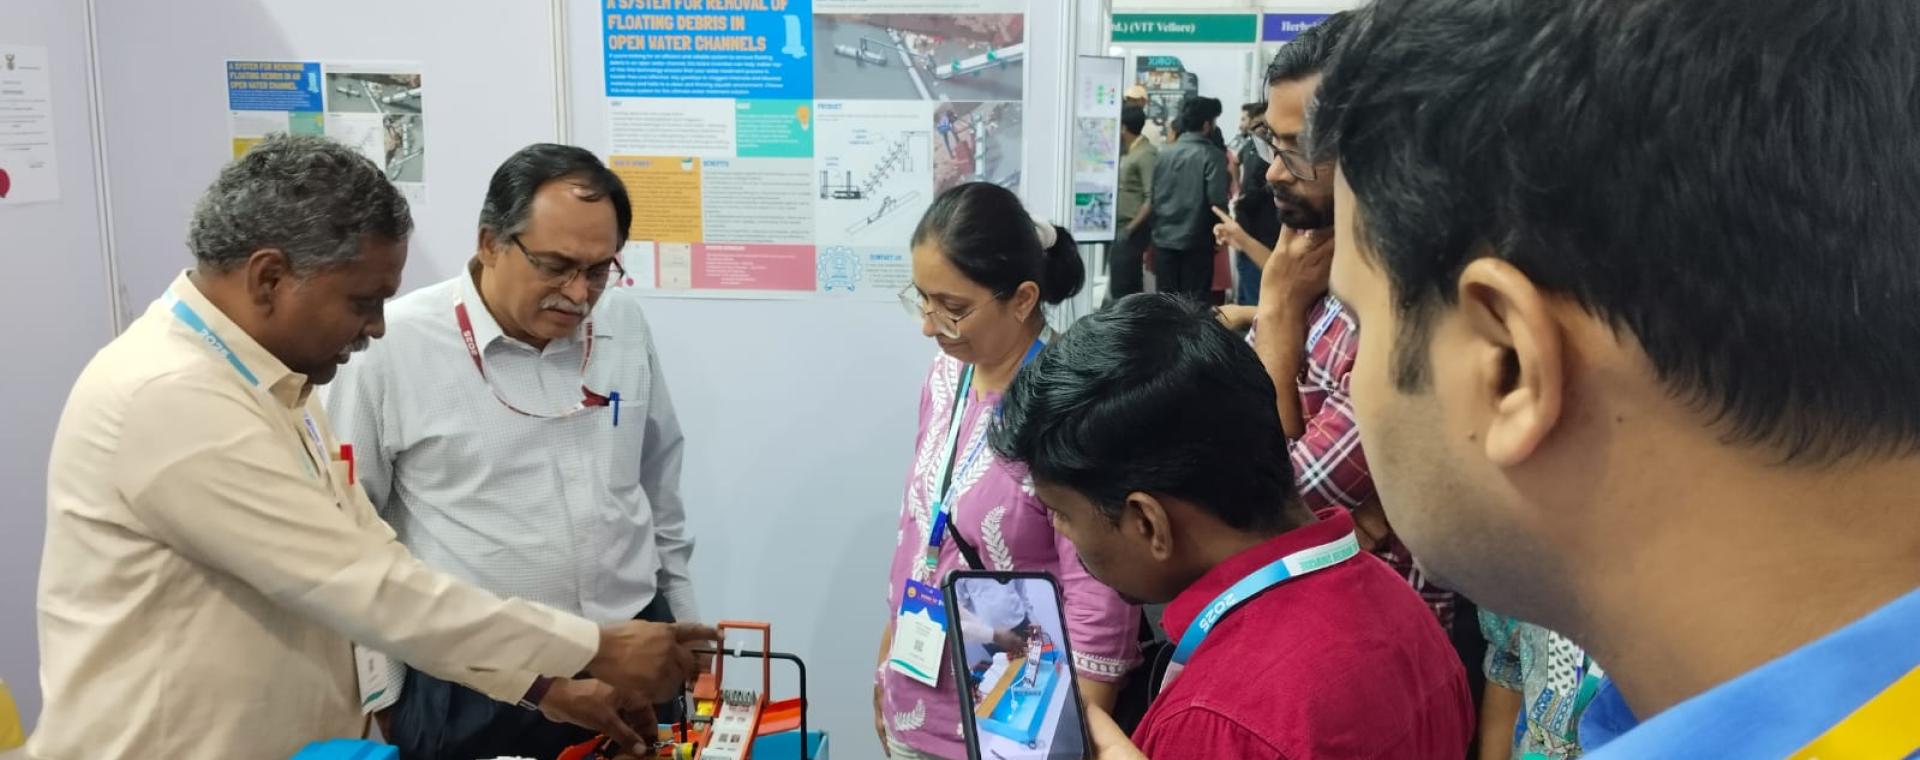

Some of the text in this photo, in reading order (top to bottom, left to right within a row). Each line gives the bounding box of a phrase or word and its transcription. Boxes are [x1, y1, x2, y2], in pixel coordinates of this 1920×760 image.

[619, 0, 672, 10] SYSTEM
[675, 0, 704, 10] FOR
[705, 0, 769, 11] REMOVAL
[771, 0, 788, 11] OF
[607, 14, 745, 31] FLOATING DEBRIS IN
[1129, 22, 1154, 34] (VIT
[1156, 22, 1196, 34] Vellore)
[608, 35, 767, 51] OPEN WATER CHANNELS
[1199, 592, 1236, 633] 2025
